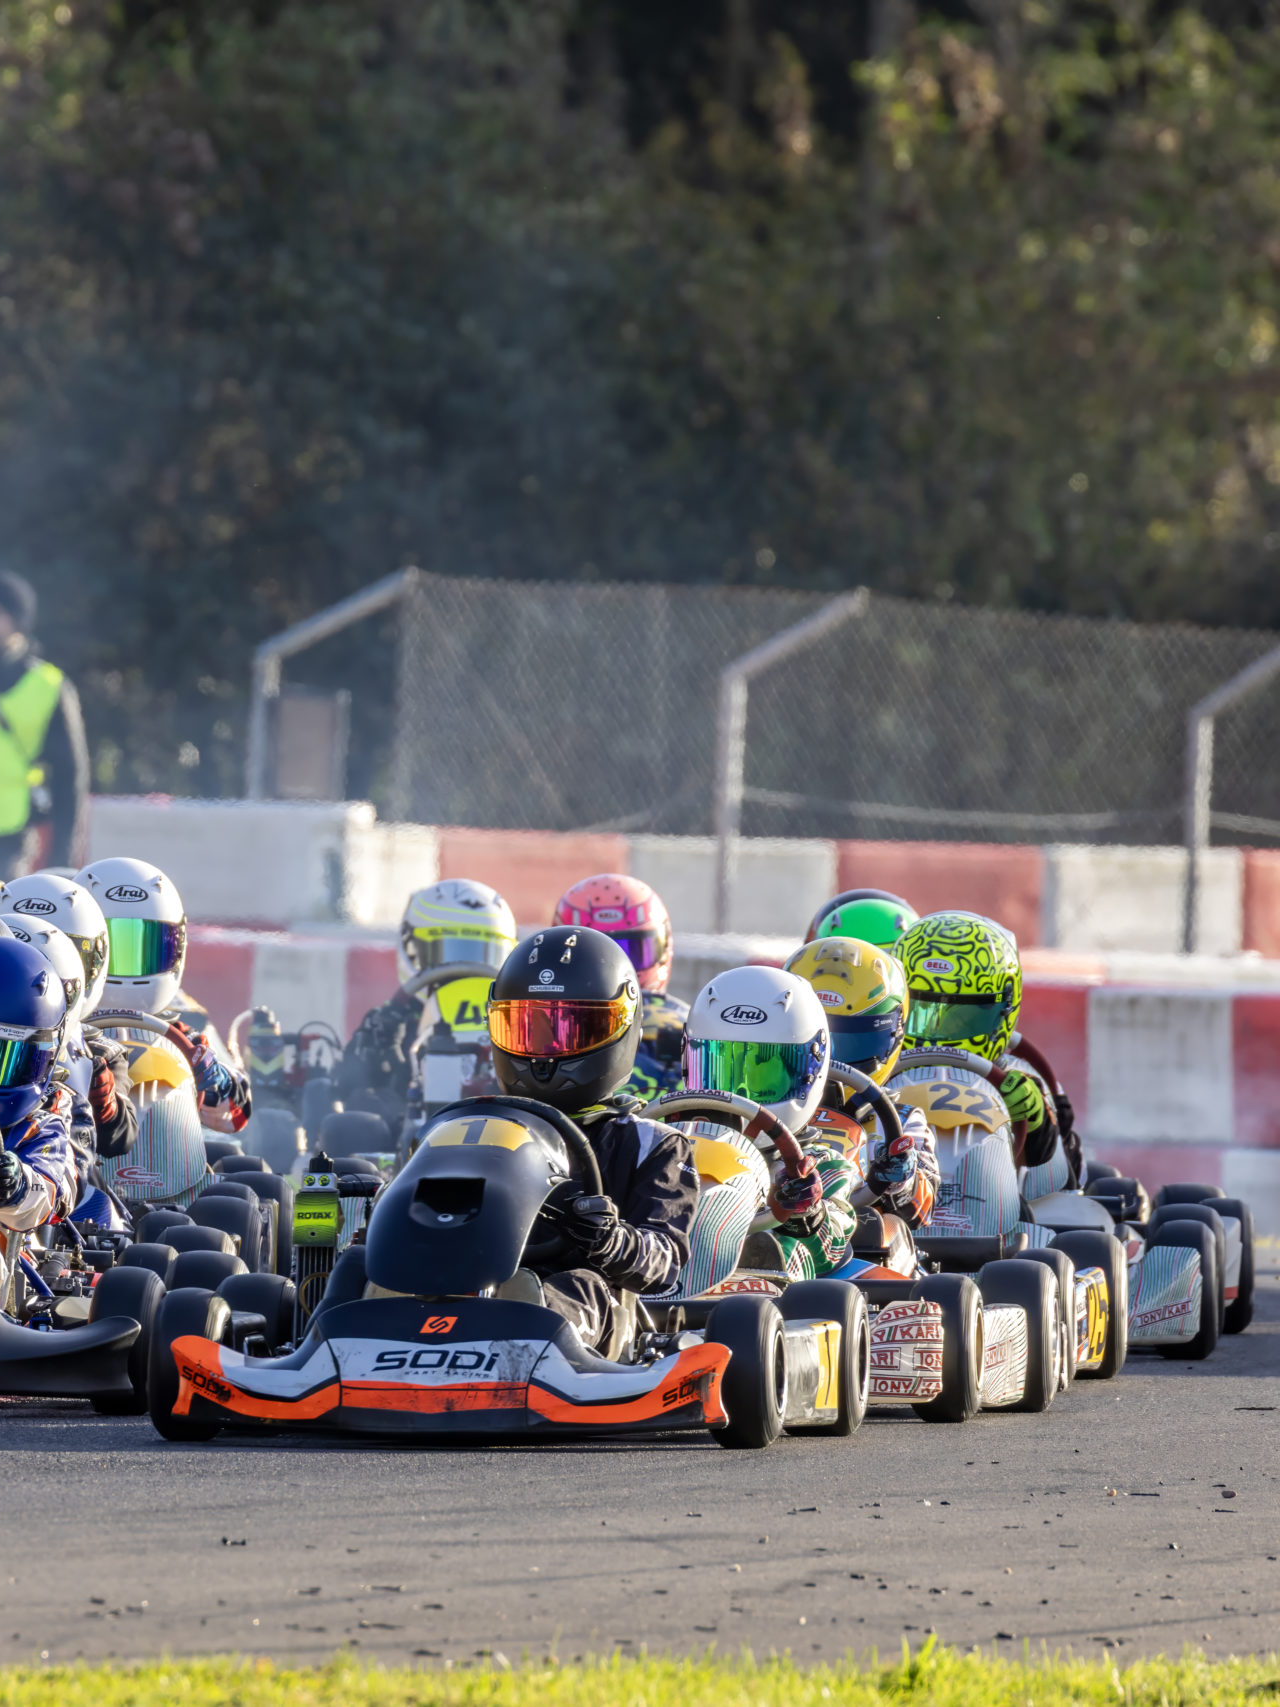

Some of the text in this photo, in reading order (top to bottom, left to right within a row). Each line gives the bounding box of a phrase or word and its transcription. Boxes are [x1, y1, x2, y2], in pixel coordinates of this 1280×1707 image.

[108, 886, 144, 898] Arai
[15, 899, 52, 911] Arai
[926, 961, 950, 970] BELL
[816, 992, 841, 1003] BELL
[723, 1006, 762, 1020] Arai
[929, 1083, 993, 1125] 22
[461, 1119, 488, 1144] 1
[297, 1211, 332, 1219] ROTAX
